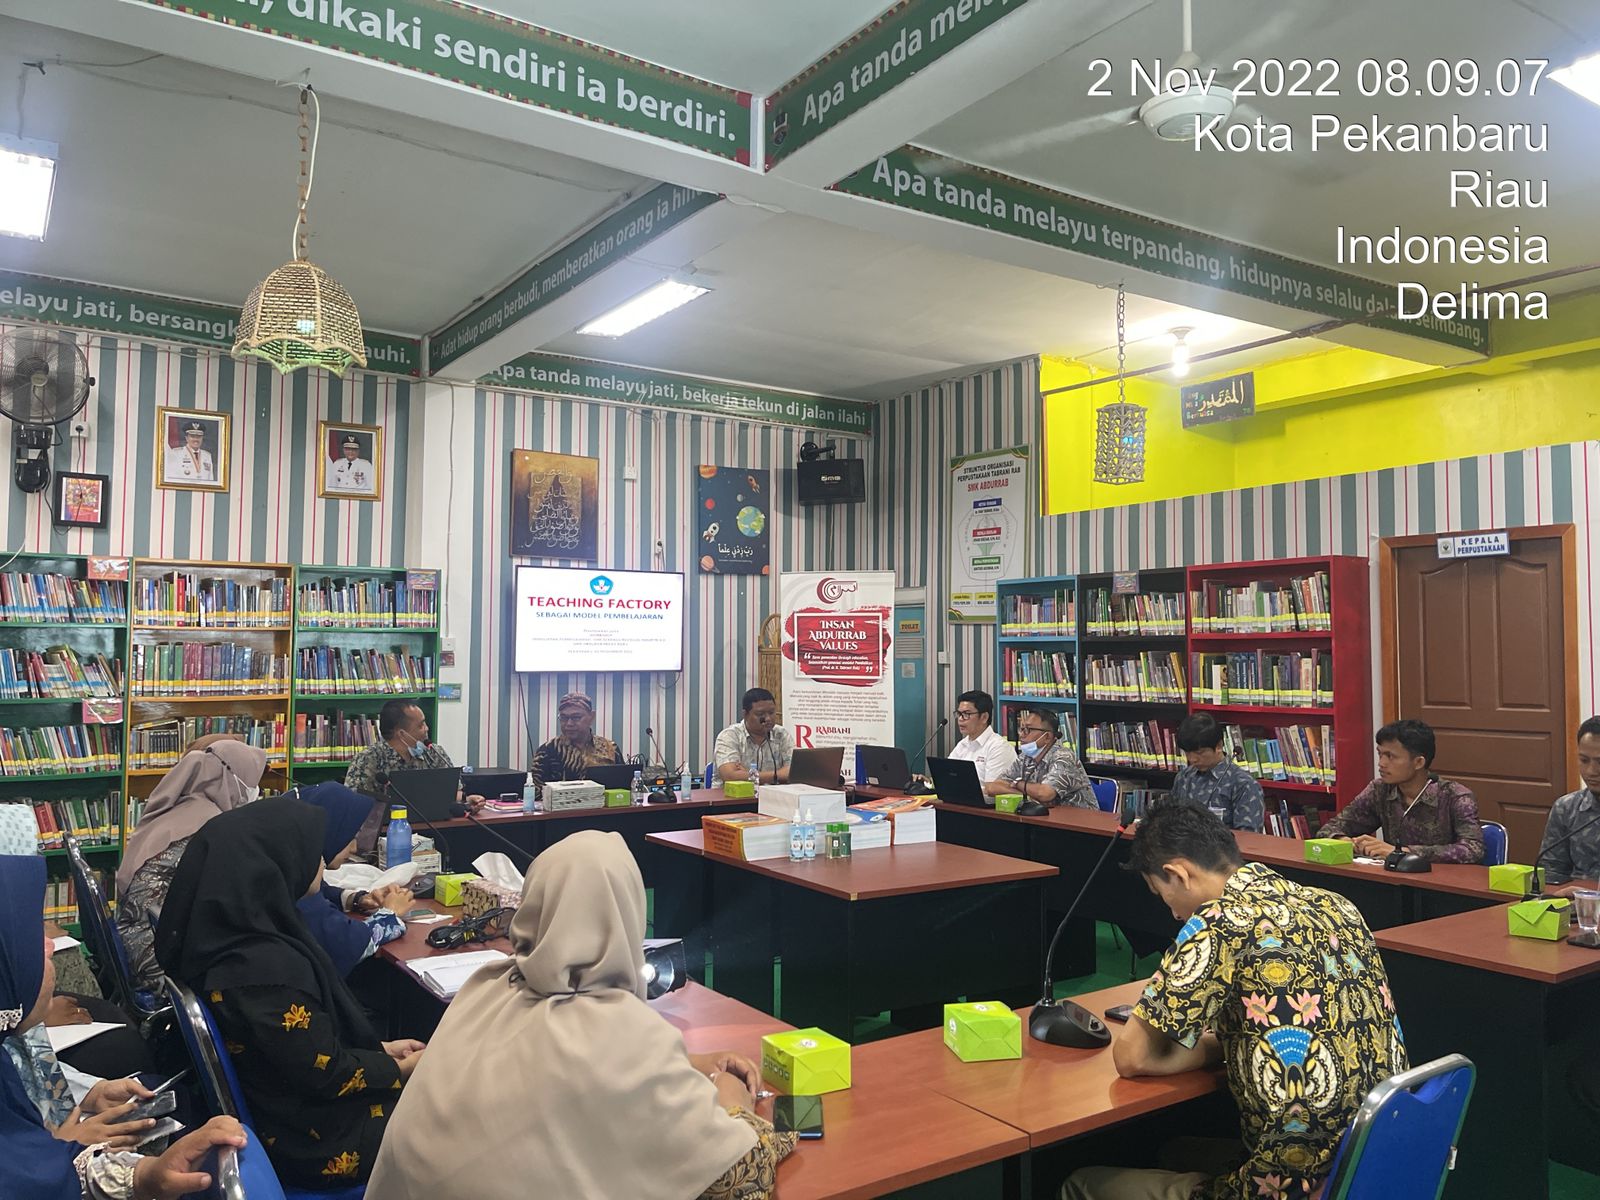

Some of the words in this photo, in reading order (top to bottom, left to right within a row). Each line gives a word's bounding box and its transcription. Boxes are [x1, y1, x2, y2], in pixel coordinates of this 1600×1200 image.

[287, 0, 421, 50] dikaki
[434, 32, 566, 92] sendiri
[577, 66, 606, 104] ia
[617, 78, 736, 141] berdiri.
[802, 81, 845, 126] Apa
[850, 27, 923, 93] tanda
[872, 156, 926, 197] Apa
[933, 176, 1007, 219] tanda
[1013, 202, 1097, 244] melayu
[1101, 224, 1226, 280] terpandang,
[1229, 256, 1313, 300] hidupnya
[1316, 284, 1363, 311] selalu
[440, 338, 457, 359] Adat
[457, 324, 479, 348] hidup
[480, 310, 503, 334] orang
[504, 281, 541, 319] berbudi,
[542, 234, 614, 294] memberatkan
[616, 210, 654, 245] orang
[656, 199, 669, 221] ia
[0, 286, 69, 314] elayu
[73, 296, 122, 322] jati,
[130, 303, 238, 340] bersangk
[364, 344, 411, 365] auhi.
[529, 366, 580, 385] tanda
[585, 374, 646, 396] melayu
[648, 380, 679, 401] jati,
[682, 385, 740, 407] bekerja
[742, 396, 783, 414] tekun
[786, 401, 799, 416] di
[801, 404, 835, 421] jalan
[838, 408, 866, 426] ilahi
[1457, 544, 1505, 555] PERPUSTAKAAN
[1461, 536, 1500, 546] KEPALA
[527, 596, 604, 609] TEACHING
[608, 598, 672, 610] FACTORY
[535, 611, 571, 619] SEBAGAI
[573, 612, 601, 620] MODEL
[819, 620, 855, 629] INSAN
[808, 630, 867, 642] ABDURRAB
[819, 641, 858, 651] VALUES
[795, 724, 815, 749] R
[815, 726, 851, 735] RABBANI
